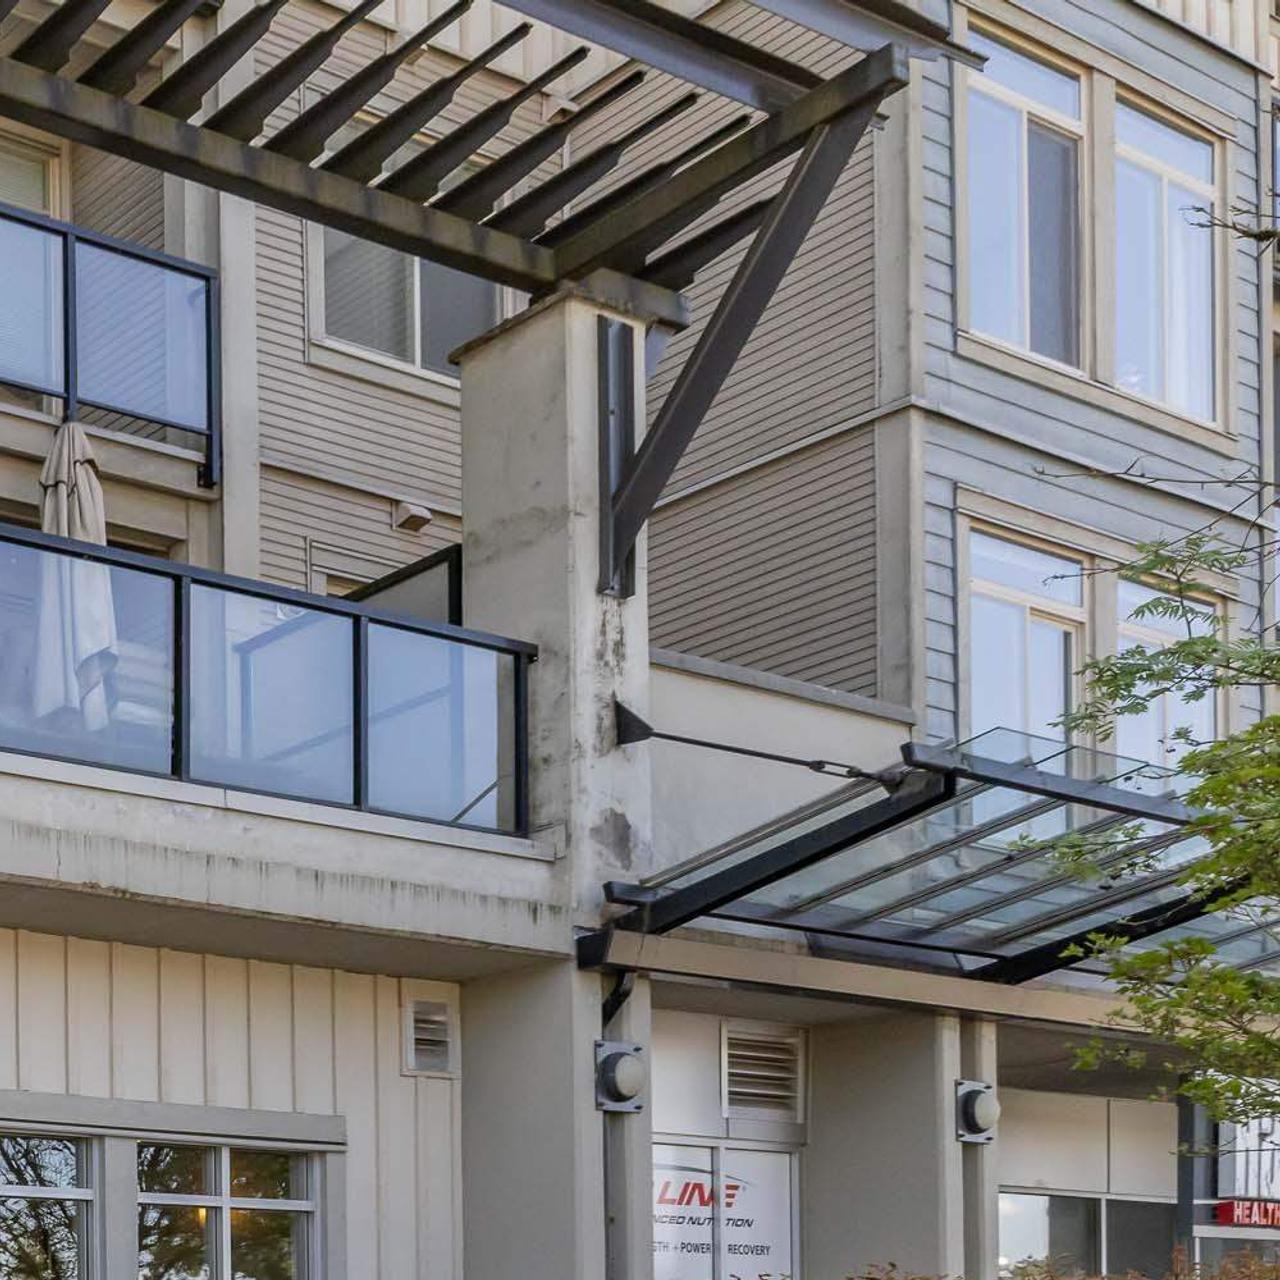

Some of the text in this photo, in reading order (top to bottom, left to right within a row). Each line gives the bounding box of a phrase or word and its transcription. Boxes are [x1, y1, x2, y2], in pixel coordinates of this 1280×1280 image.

[686, 1216, 754, 1228] NUTTION
[680, 1241, 712, 1254] POWER
[727, 1243, 771, 1256] RECOVERY
